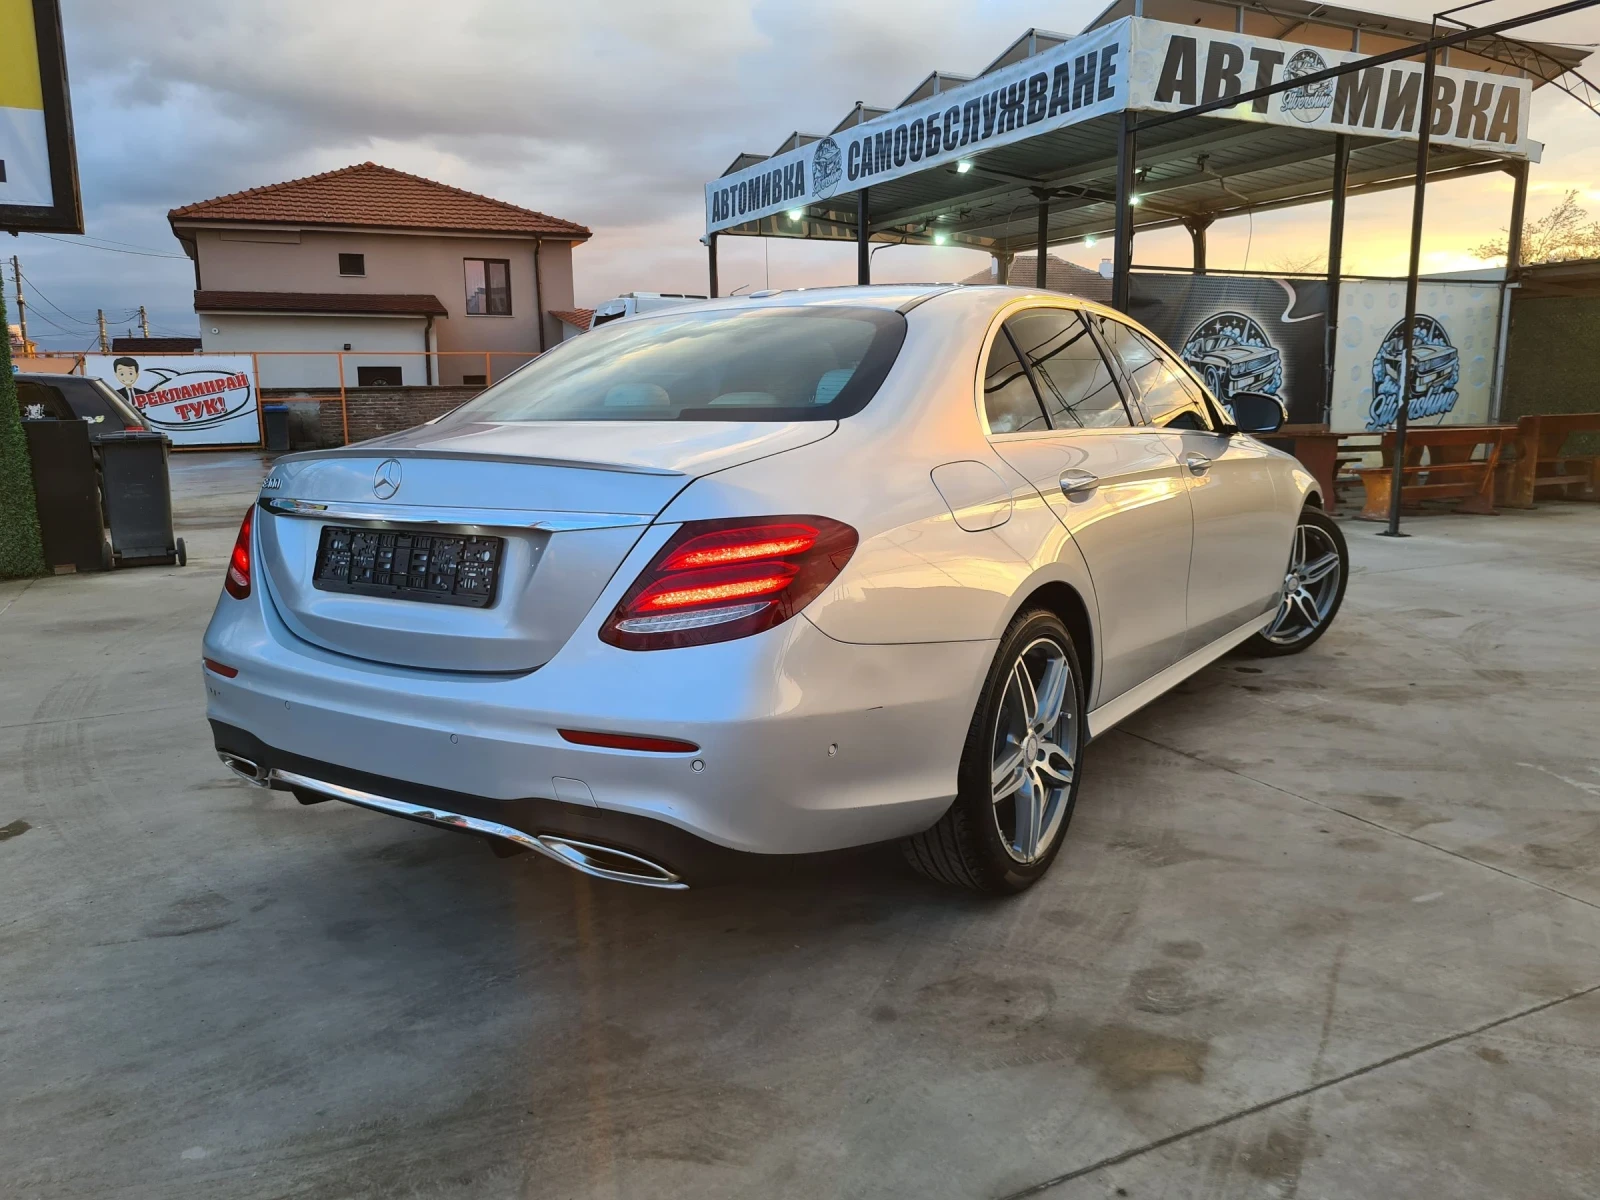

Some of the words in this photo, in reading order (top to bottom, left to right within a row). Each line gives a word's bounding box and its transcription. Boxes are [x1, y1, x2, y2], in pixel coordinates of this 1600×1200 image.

[711, 159, 806, 223] АВТОМИВКА
[847, 42, 1119, 182] САМООБСЛУЖВАНЕ
[134, 371, 250, 408] РЕКЛАМИРАЙ
[174, 396, 227, 421] ТУК!
[1366, 385, 1459, 431] Silvrshine
